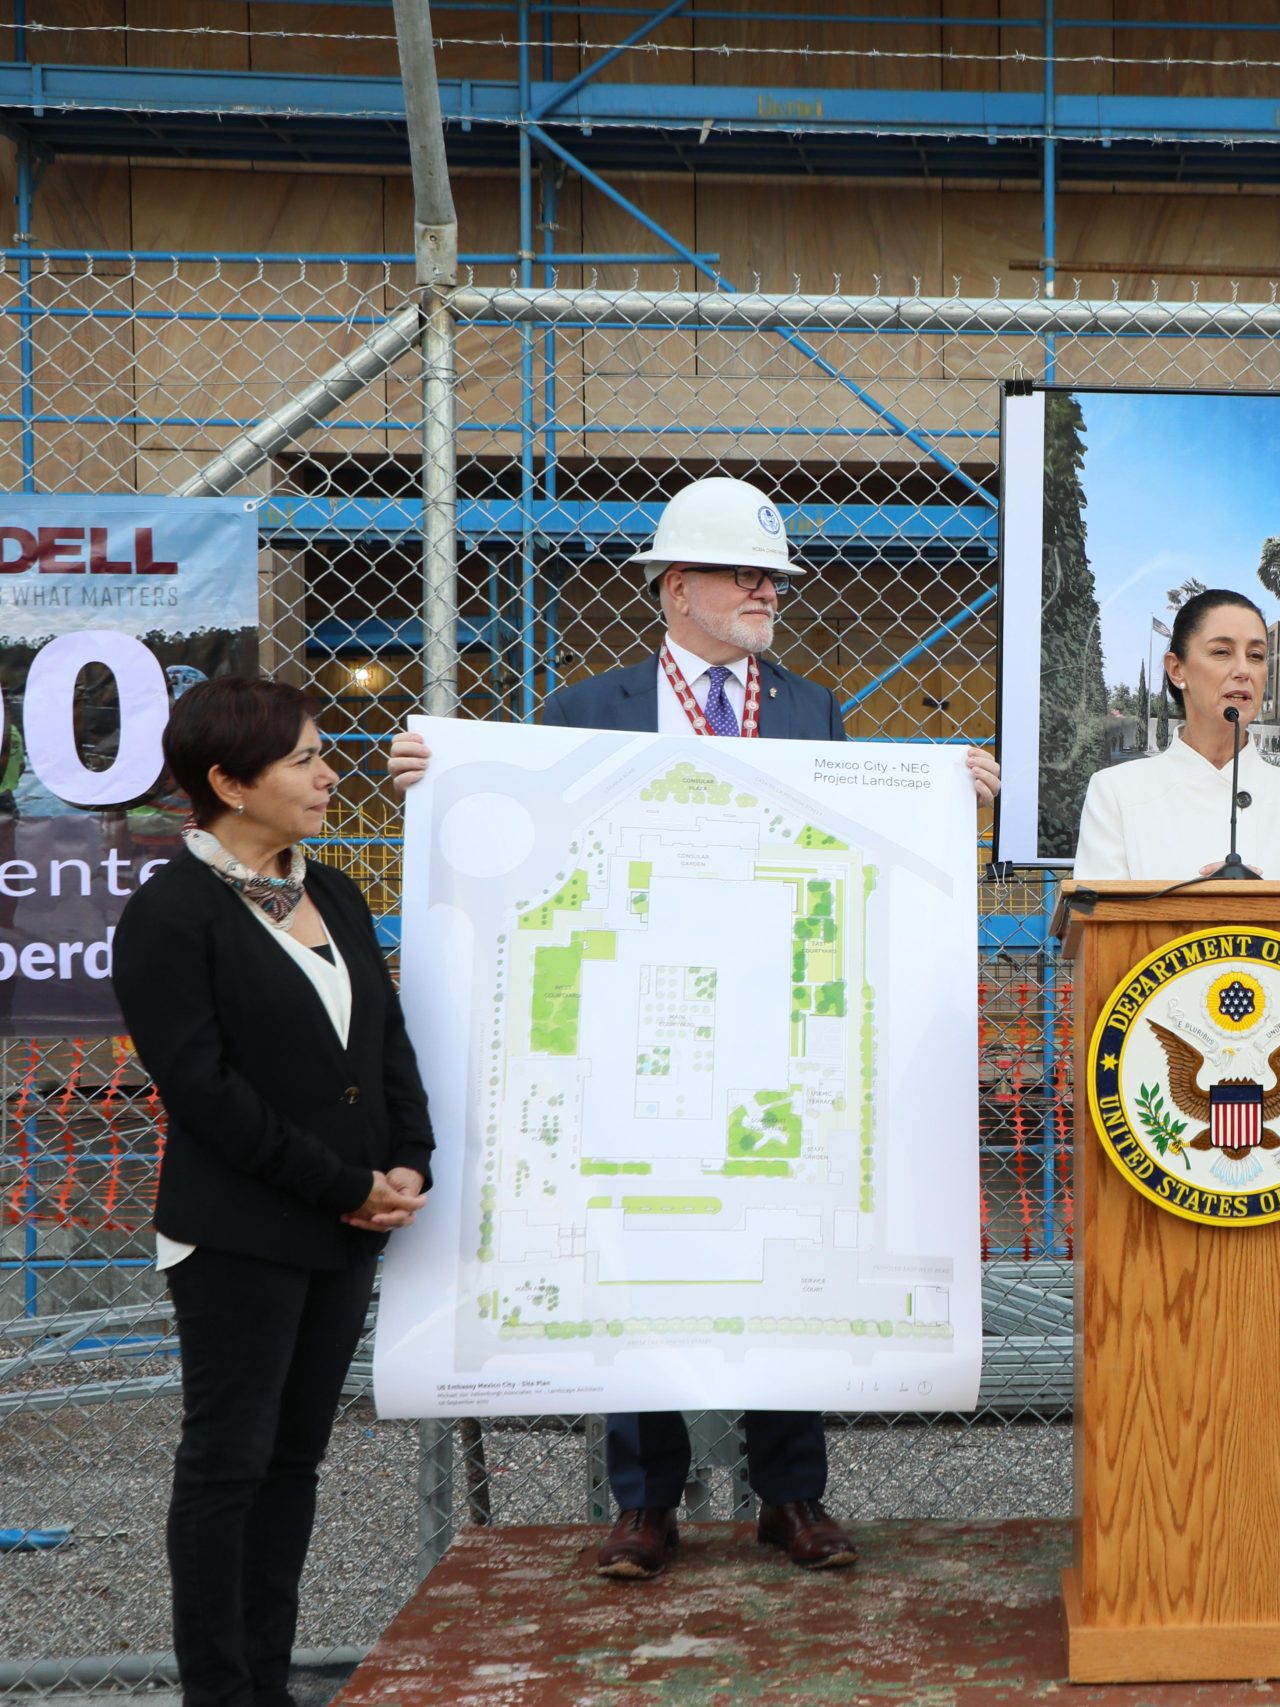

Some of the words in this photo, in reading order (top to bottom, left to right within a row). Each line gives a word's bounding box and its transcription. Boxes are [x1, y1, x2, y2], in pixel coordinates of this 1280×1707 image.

[13, 586, 72, 606] WHAT
[82, 586, 179, 606] MATTERS
[814, 758, 860, 770] Mexico
[863, 760, 888, 774] City
[901, 762, 930, 774] NEC
[814, 772, 858, 786] Project
[862, 775, 931, 789] Landscape
[1108, 936, 1252, 1033] DEPARTMENT
[1177, 1020, 1183, 1028] E
[1184, 1023, 1215, 1046] PLURIBUS
[1099, 1094, 1154, 1185] UNITED
[1155, 1177, 1248, 1217] STATES
[446, 1383, 476, 1391] Embassy
[502, 1380, 516, 1389] City
